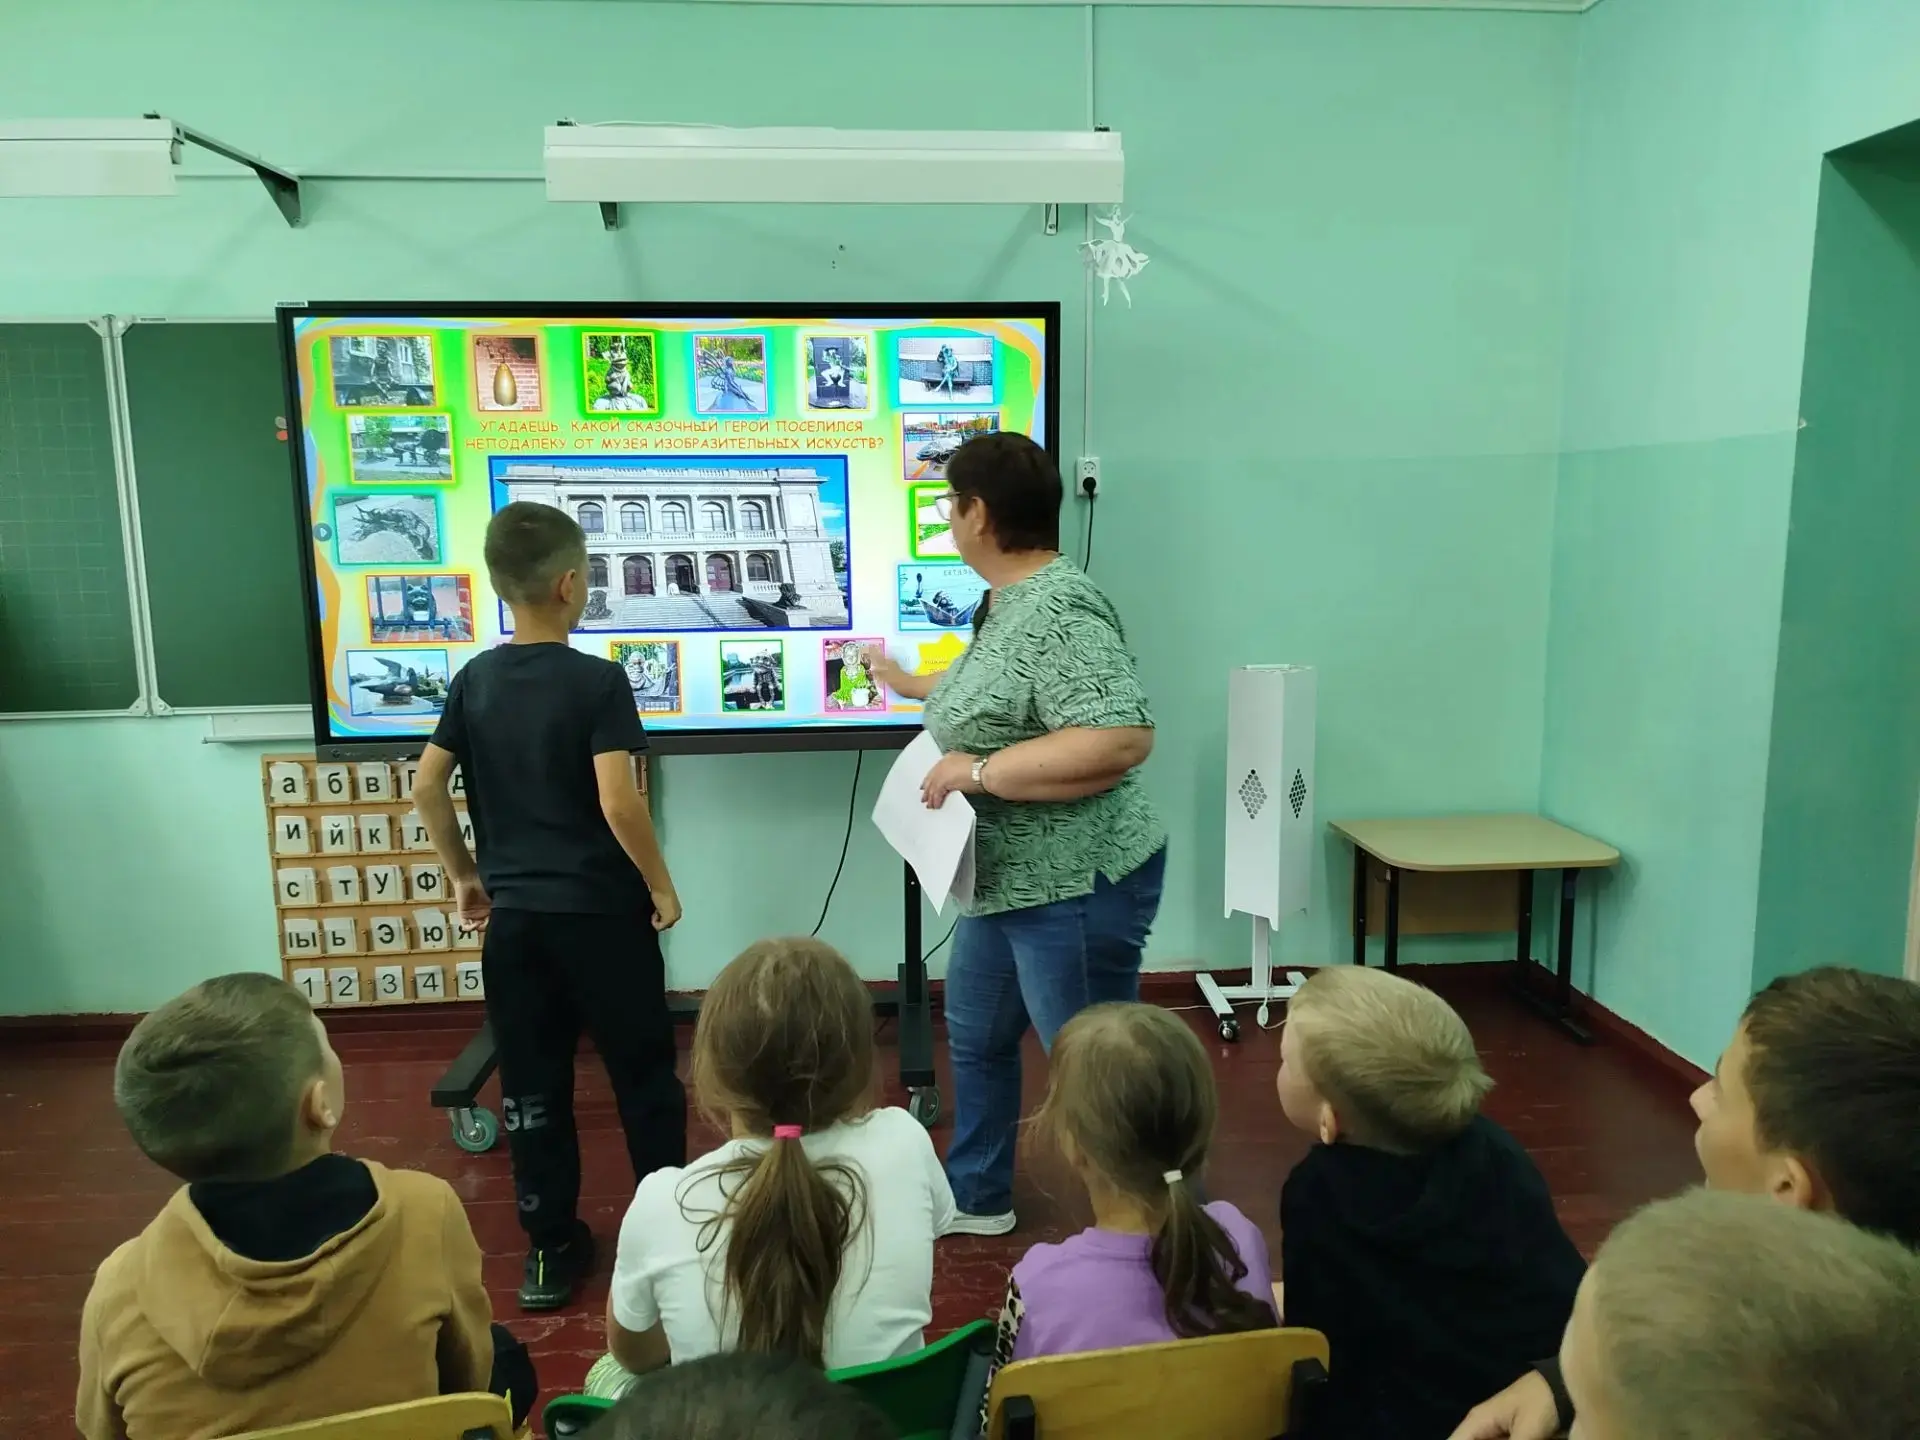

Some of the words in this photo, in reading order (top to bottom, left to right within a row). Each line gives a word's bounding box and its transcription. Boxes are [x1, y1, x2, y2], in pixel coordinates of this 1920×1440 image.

[571, 418, 620, 433] КАКОЙ
[627, 417, 717, 433] СКАЗОЧНЫЙ
[724, 417, 769, 433] ГЕРОЙ
[776, 420, 862, 433] ПОСЕЛИЛСЯ
[574, 437, 594, 449] ОТ
[601, 437, 648, 449] МУЗЕЯ
[654, 437, 800, 450] ИЗОБРАЗИТЕЛЬНЫХ
[806, 437, 884, 449] ИСКУССТВ?
[283, 777, 296, 793] а
[328, 772, 343, 794] б
[330, 823, 344, 846] й
[302, 978, 313, 997] 1
[338, 976, 353, 996] 2
[382, 974, 397, 994] 3
[422, 973, 438, 992] 4
[464, 970, 479, 990] 5
